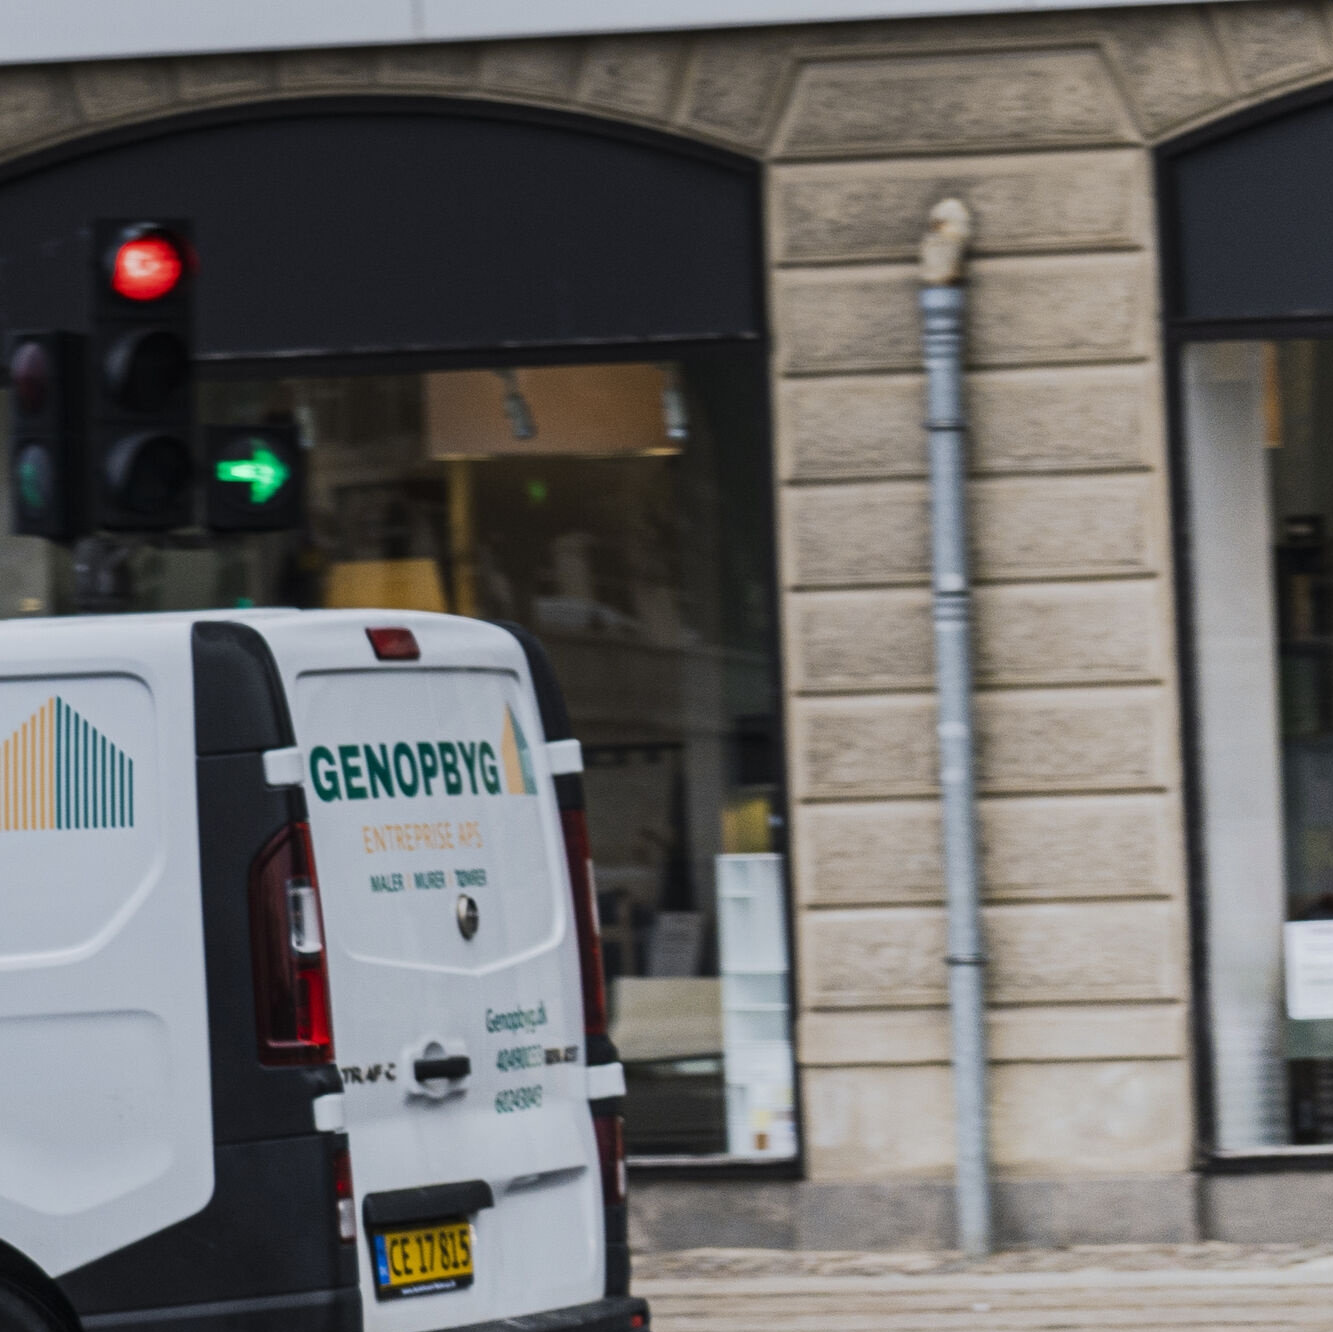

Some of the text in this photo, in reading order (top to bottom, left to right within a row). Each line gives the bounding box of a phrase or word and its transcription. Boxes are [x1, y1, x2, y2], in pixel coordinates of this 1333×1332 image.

[309, 741, 502, 803] GENOPBYG
[362, 821, 456, 854] ENTREPRISE
[389, 1229, 471, 1277] CE 17 815
